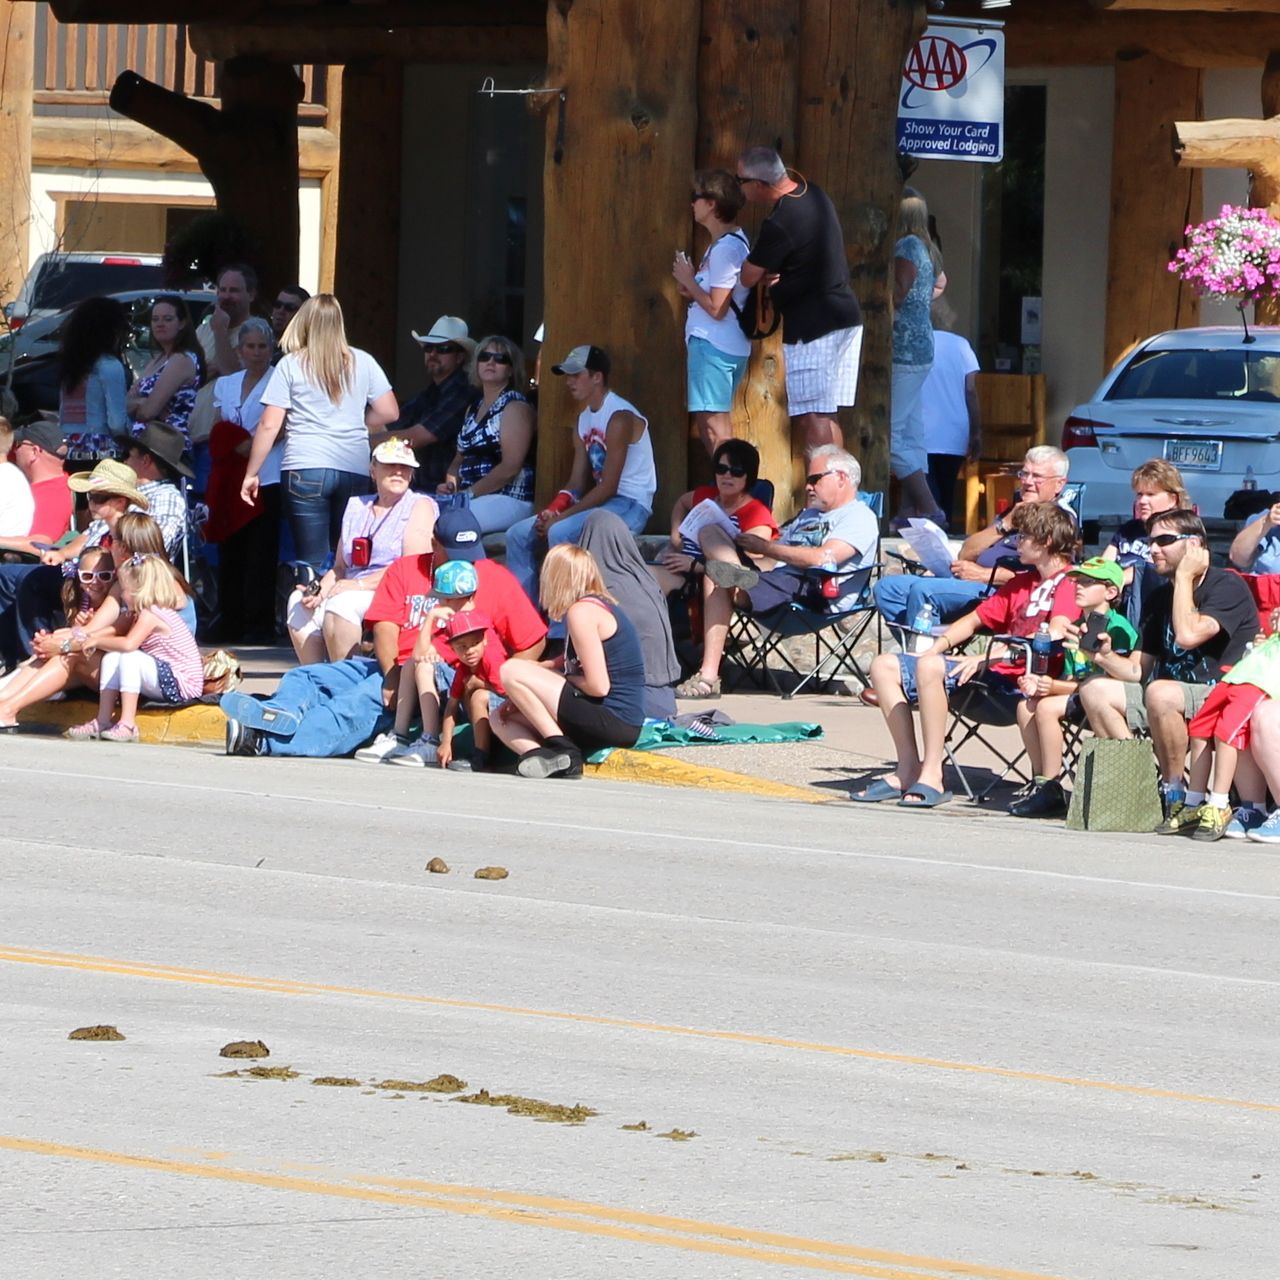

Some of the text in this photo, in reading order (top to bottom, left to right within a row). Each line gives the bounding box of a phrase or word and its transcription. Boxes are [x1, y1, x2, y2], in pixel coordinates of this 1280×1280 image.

[904, 37, 966, 90] AAA
[905, 122, 990, 138] Show Your Card
[898, 136, 995, 154] Approved Lodging
